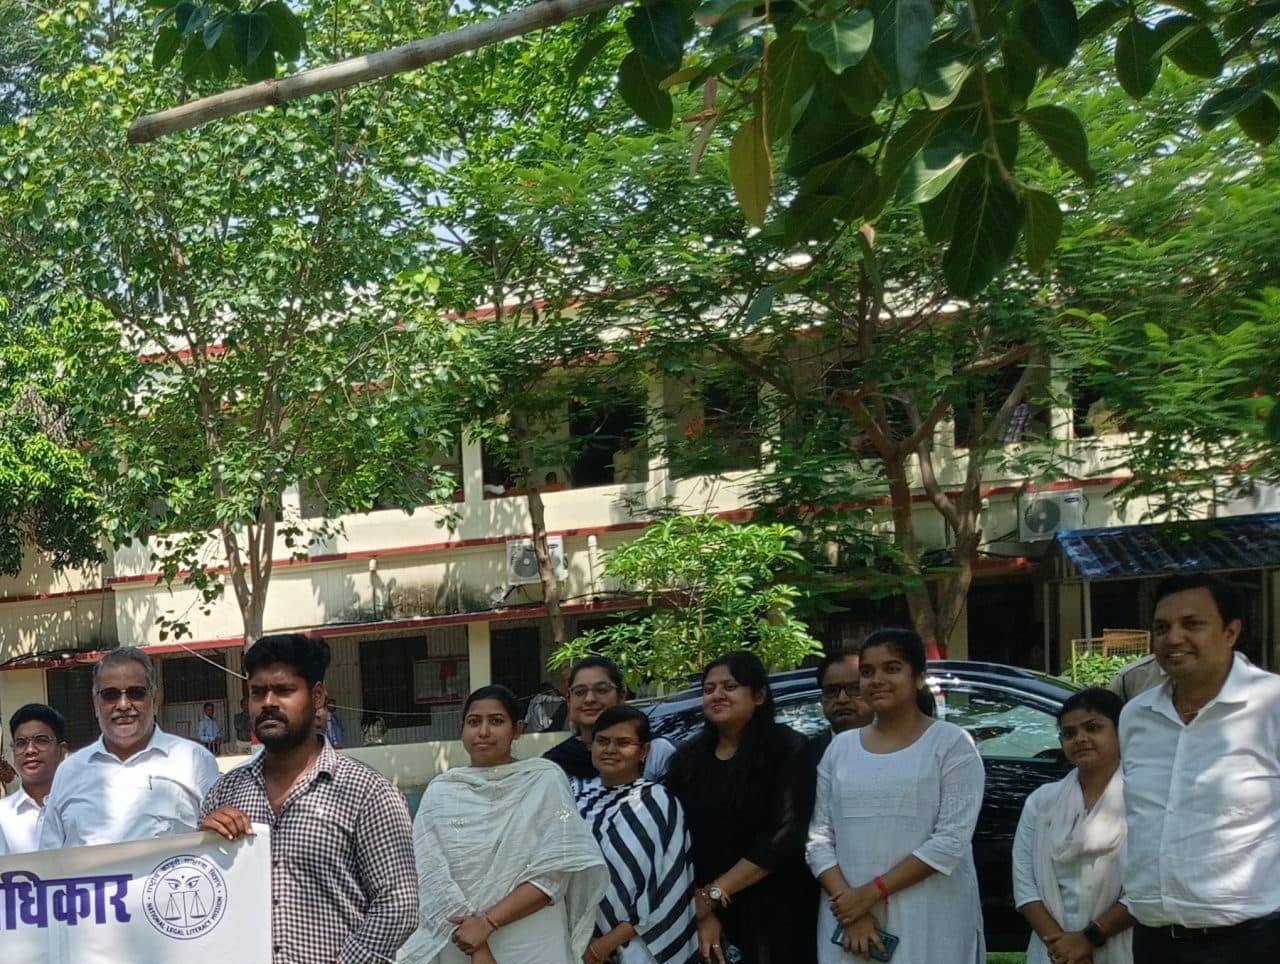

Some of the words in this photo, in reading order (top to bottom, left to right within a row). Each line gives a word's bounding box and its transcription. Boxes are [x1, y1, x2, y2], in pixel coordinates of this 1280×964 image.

[147, 902, 166, 929] NATIONAL
[166, 925, 184, 935] LEGAL
[186, 919, 212, 936] LITERACY
